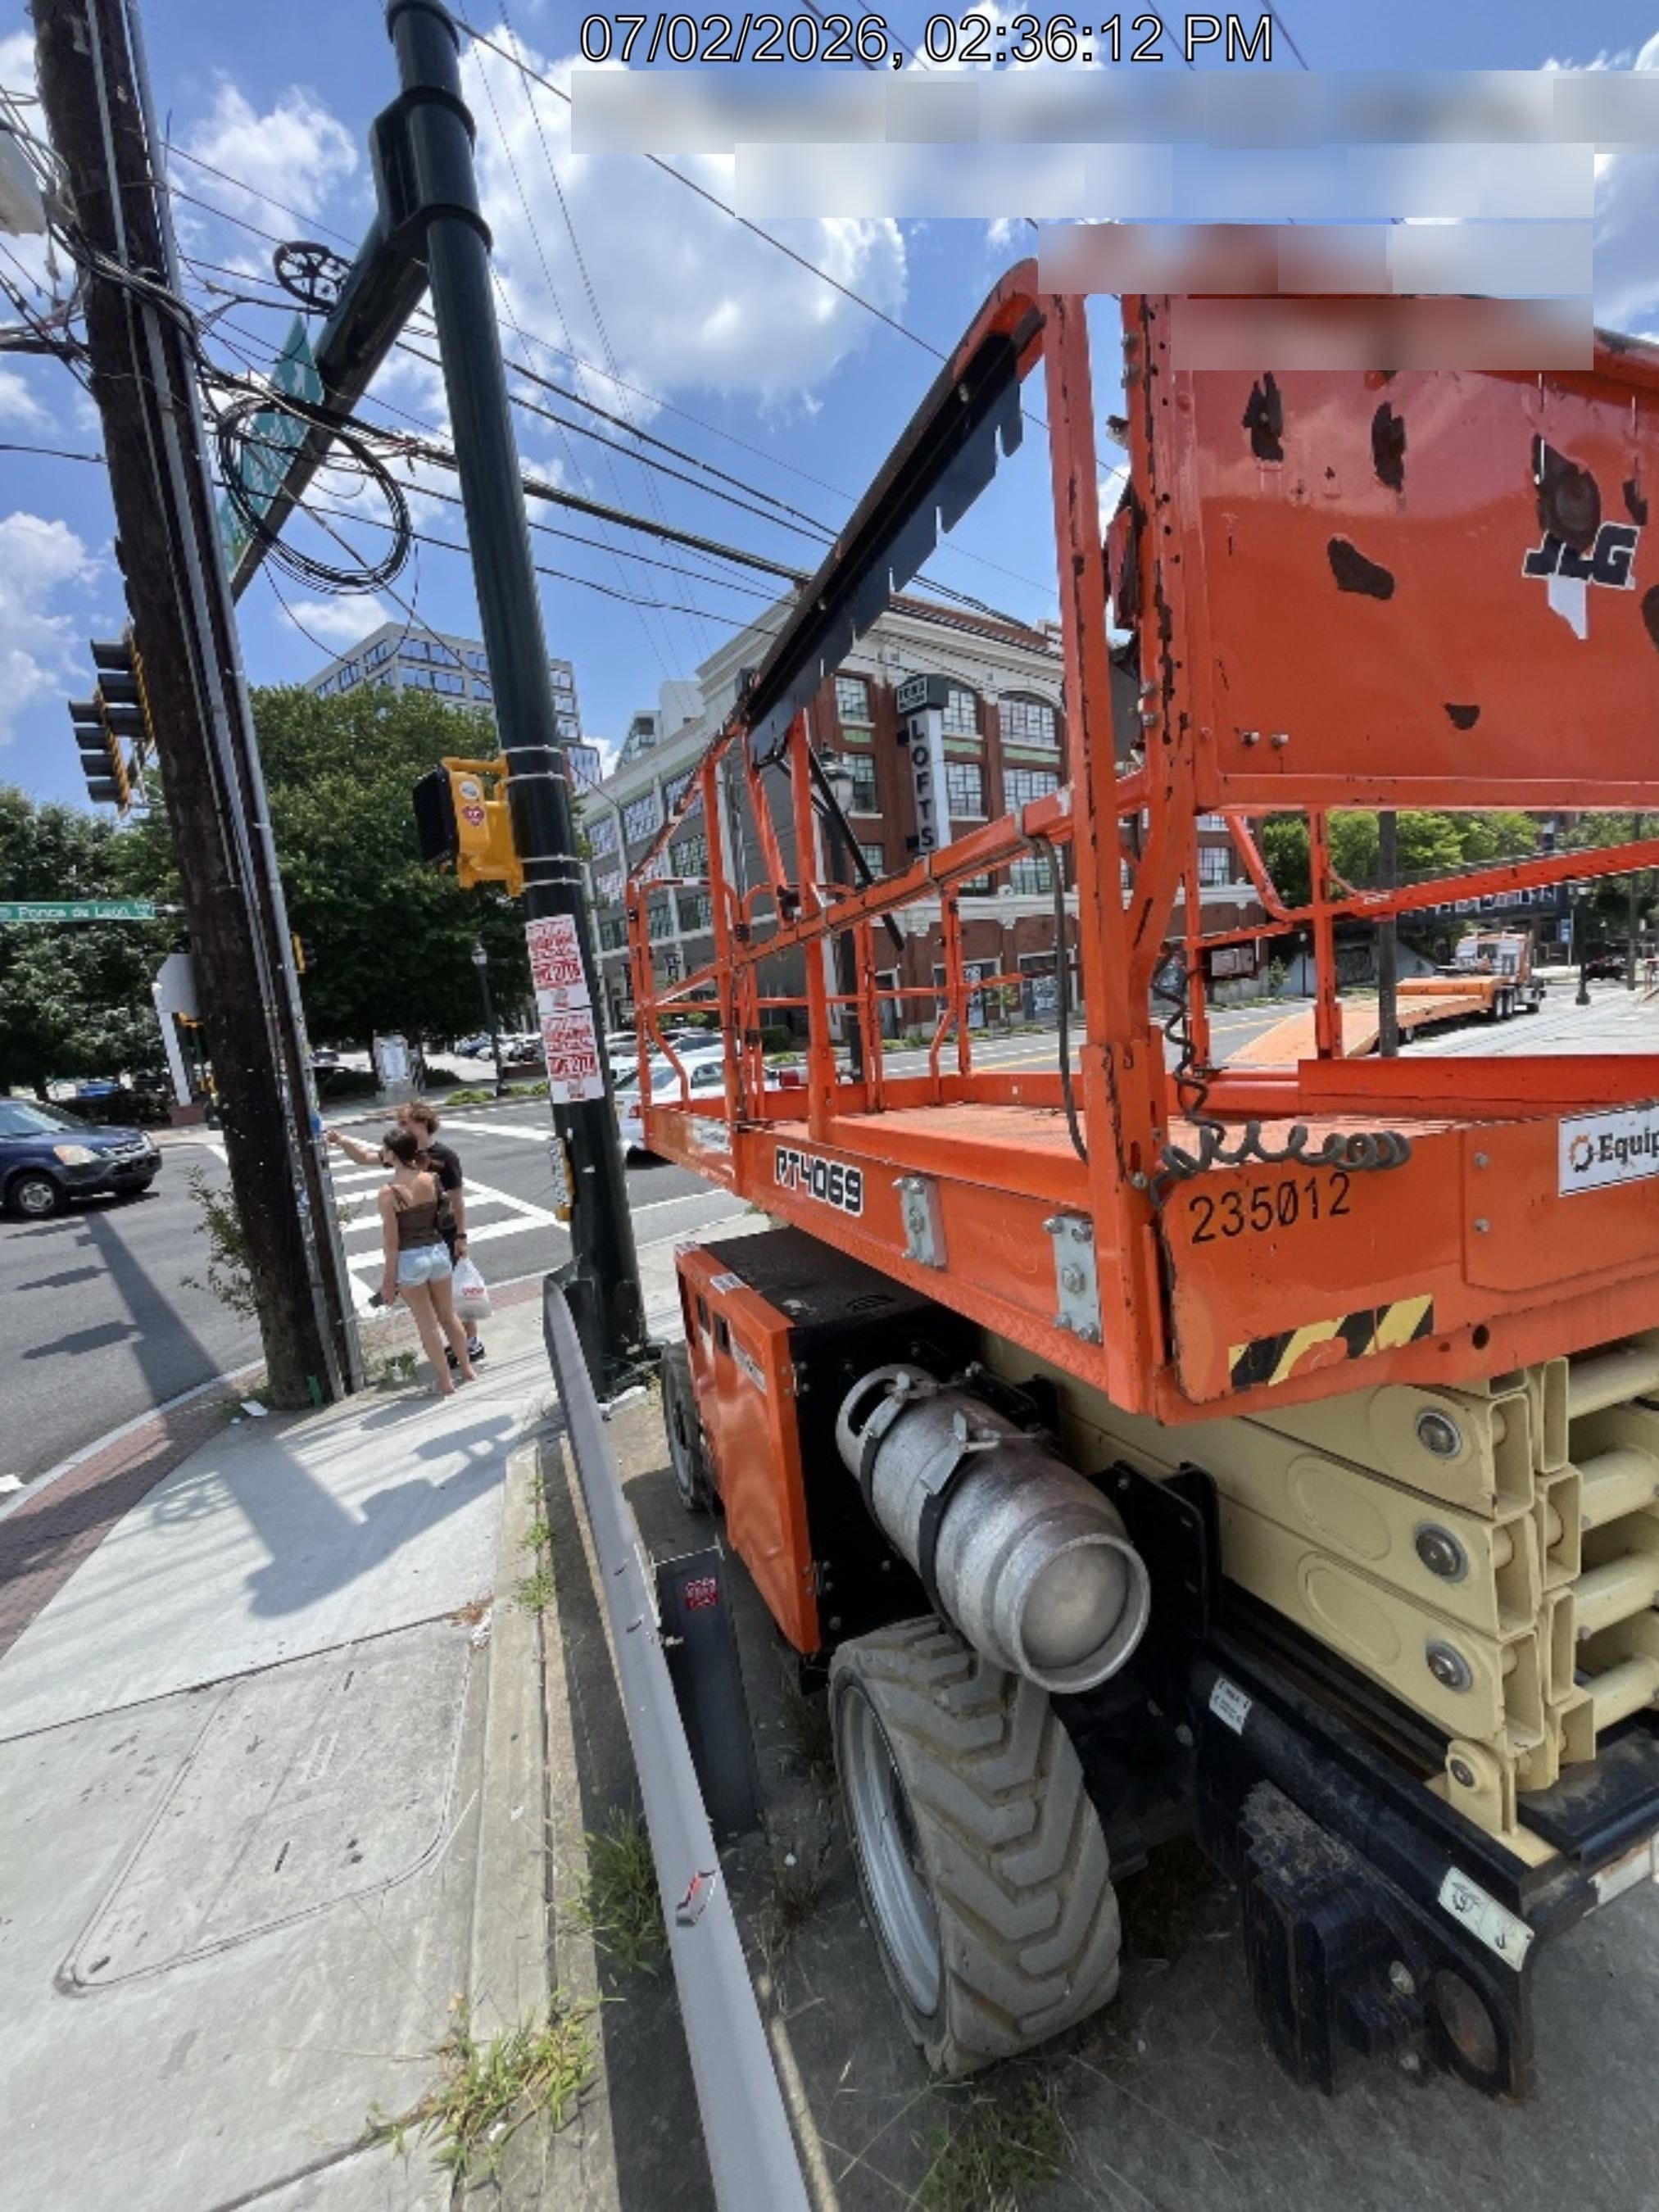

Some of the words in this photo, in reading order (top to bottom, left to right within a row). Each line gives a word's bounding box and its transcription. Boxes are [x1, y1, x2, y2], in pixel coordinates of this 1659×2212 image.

[911, 718, 935, 848] LOFTS
[774, 1145, 864, 1217] RT4069
[1189, 1172, 1350, 1244] 235012
